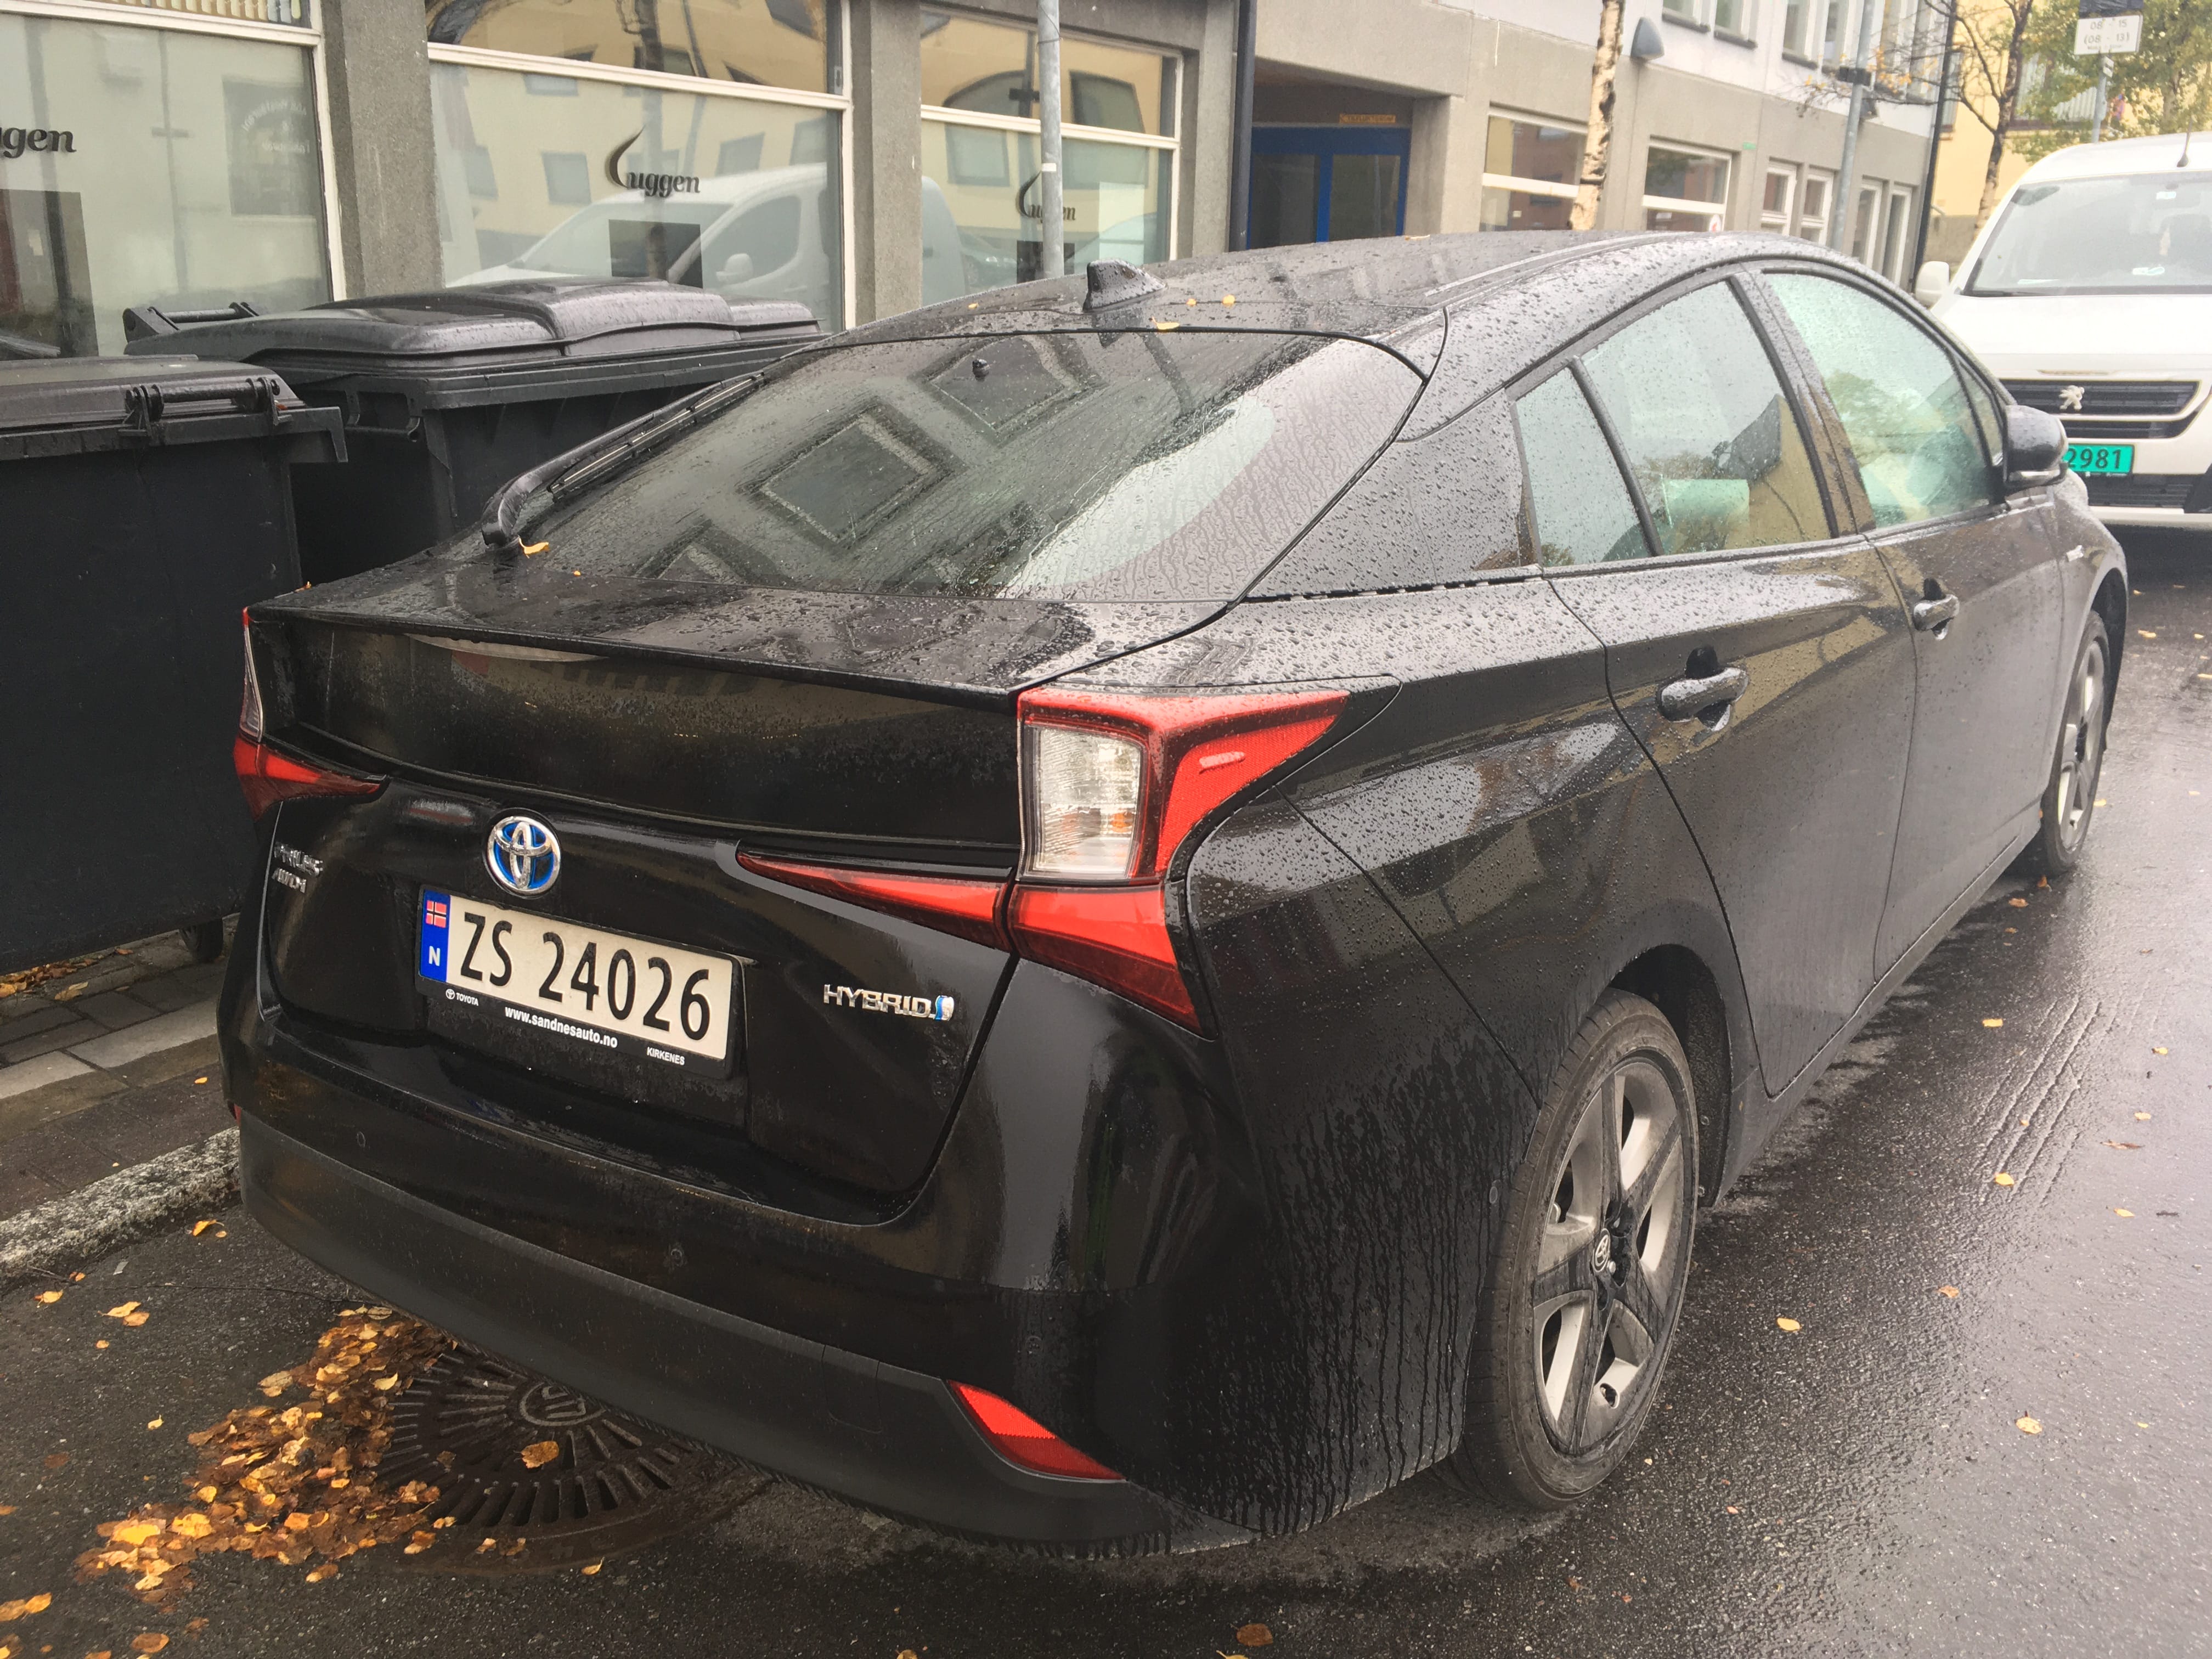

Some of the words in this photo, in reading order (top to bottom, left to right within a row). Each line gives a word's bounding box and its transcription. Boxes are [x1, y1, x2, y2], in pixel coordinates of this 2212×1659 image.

[2118, 19, 2128, 27] 15
[0, 127, 77, 159] gen
[428, 946, 441, 967] N
[461, 912, 512, 987] ZS
[539, 932, 710, 1041] 24026
[823, 984, 932, 1018] HYBRID
[456, 992, 479, 1007] TOYOTA
[504, 1006, 618, 1048] www.sandnesauto.no
[647, 1046, 685, 1066] KIRKENES
